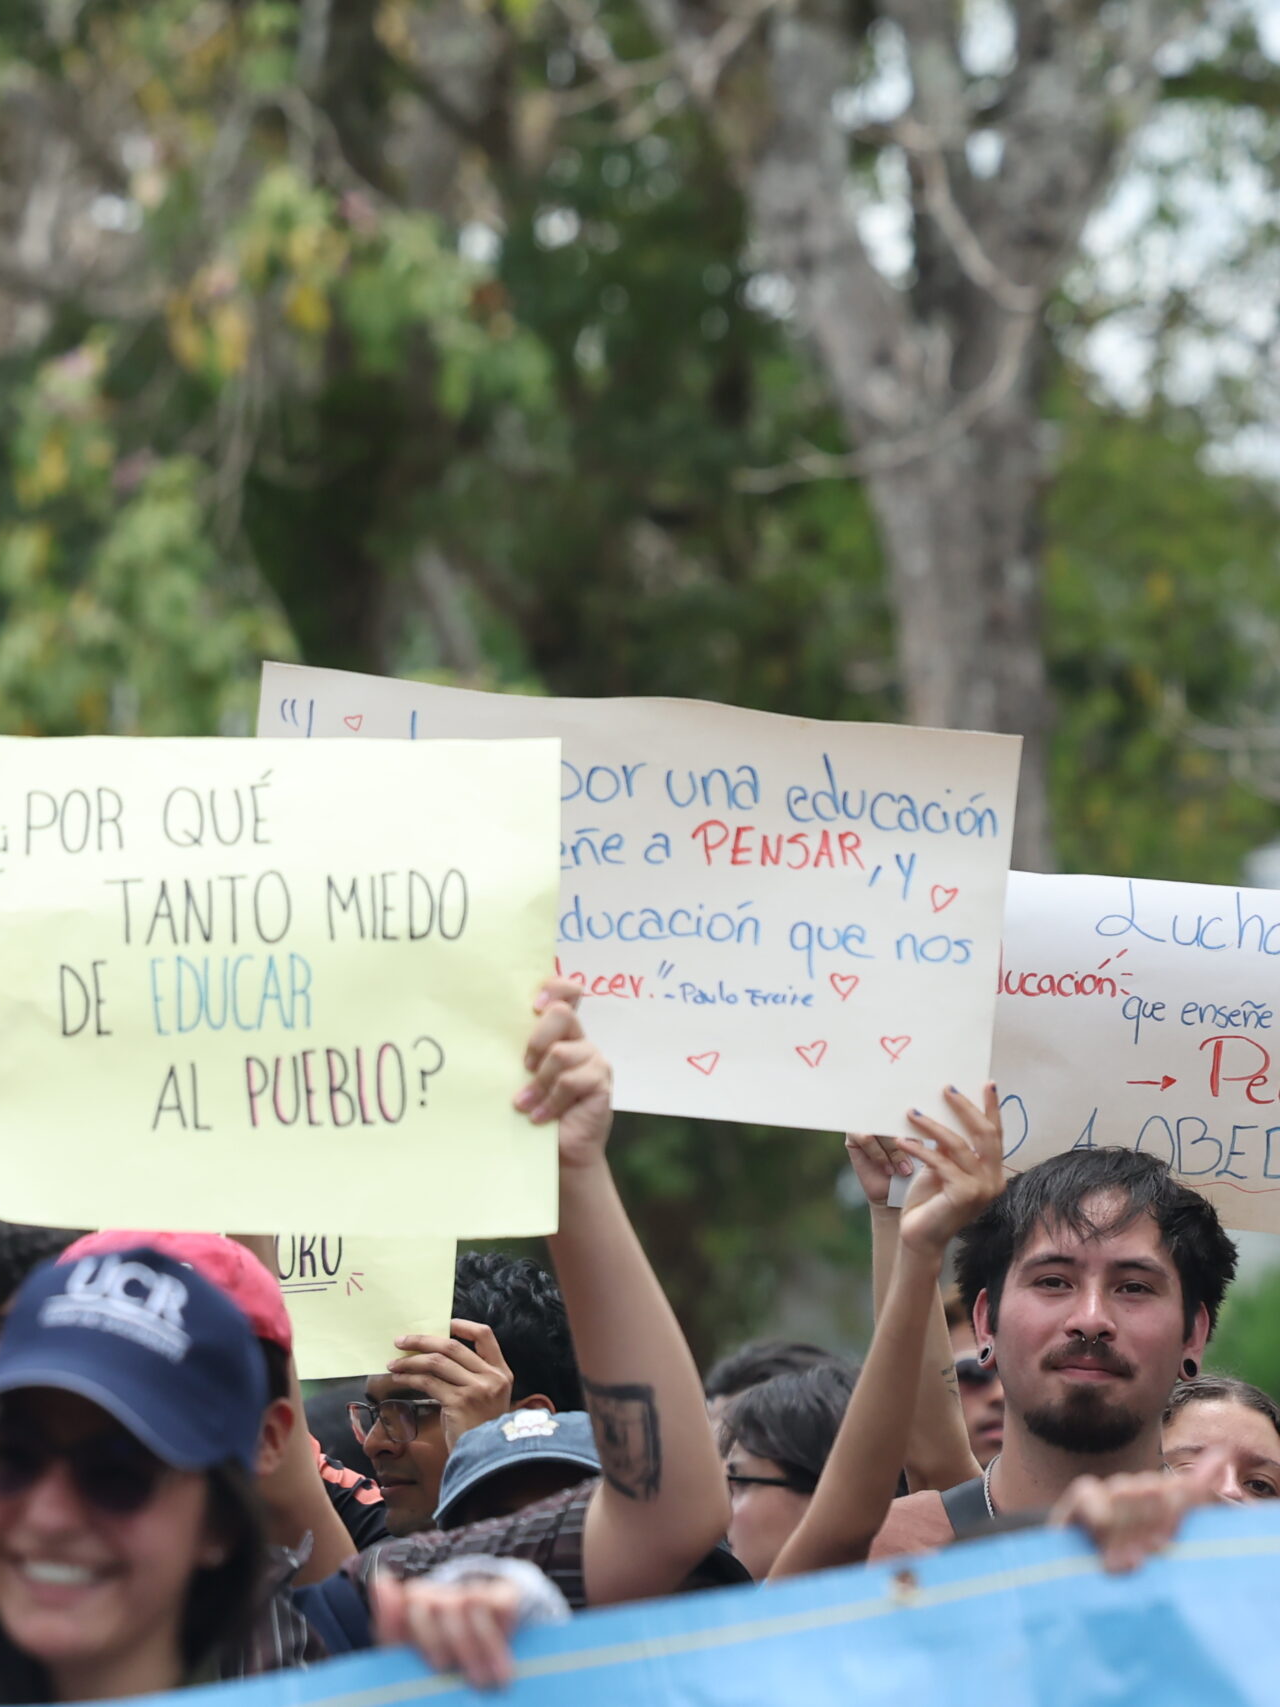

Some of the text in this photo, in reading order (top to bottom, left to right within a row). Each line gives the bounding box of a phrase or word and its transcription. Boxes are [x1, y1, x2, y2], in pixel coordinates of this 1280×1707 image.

[162, 768, 275, 848] QUÉ
[664, 763, 761, 811] una
[785, 752, 999, 839] educación
[560, 827, 626, 871] ñe
[642, 831, 673, 866] a
[103, 867, 470, 946] TANTO MIEDO
[556, 893, 974, 981] ducación que nos
[58, 951, 315, 1039] DE EDUCAR
[1121, 994, 1275, 1045] que enseñe
[150, 1036, 446, 1132] AL PUEBLO?
[1197, 1034, 1280, 1106] Pe
[66, 1253, 190, 1328] UCR
